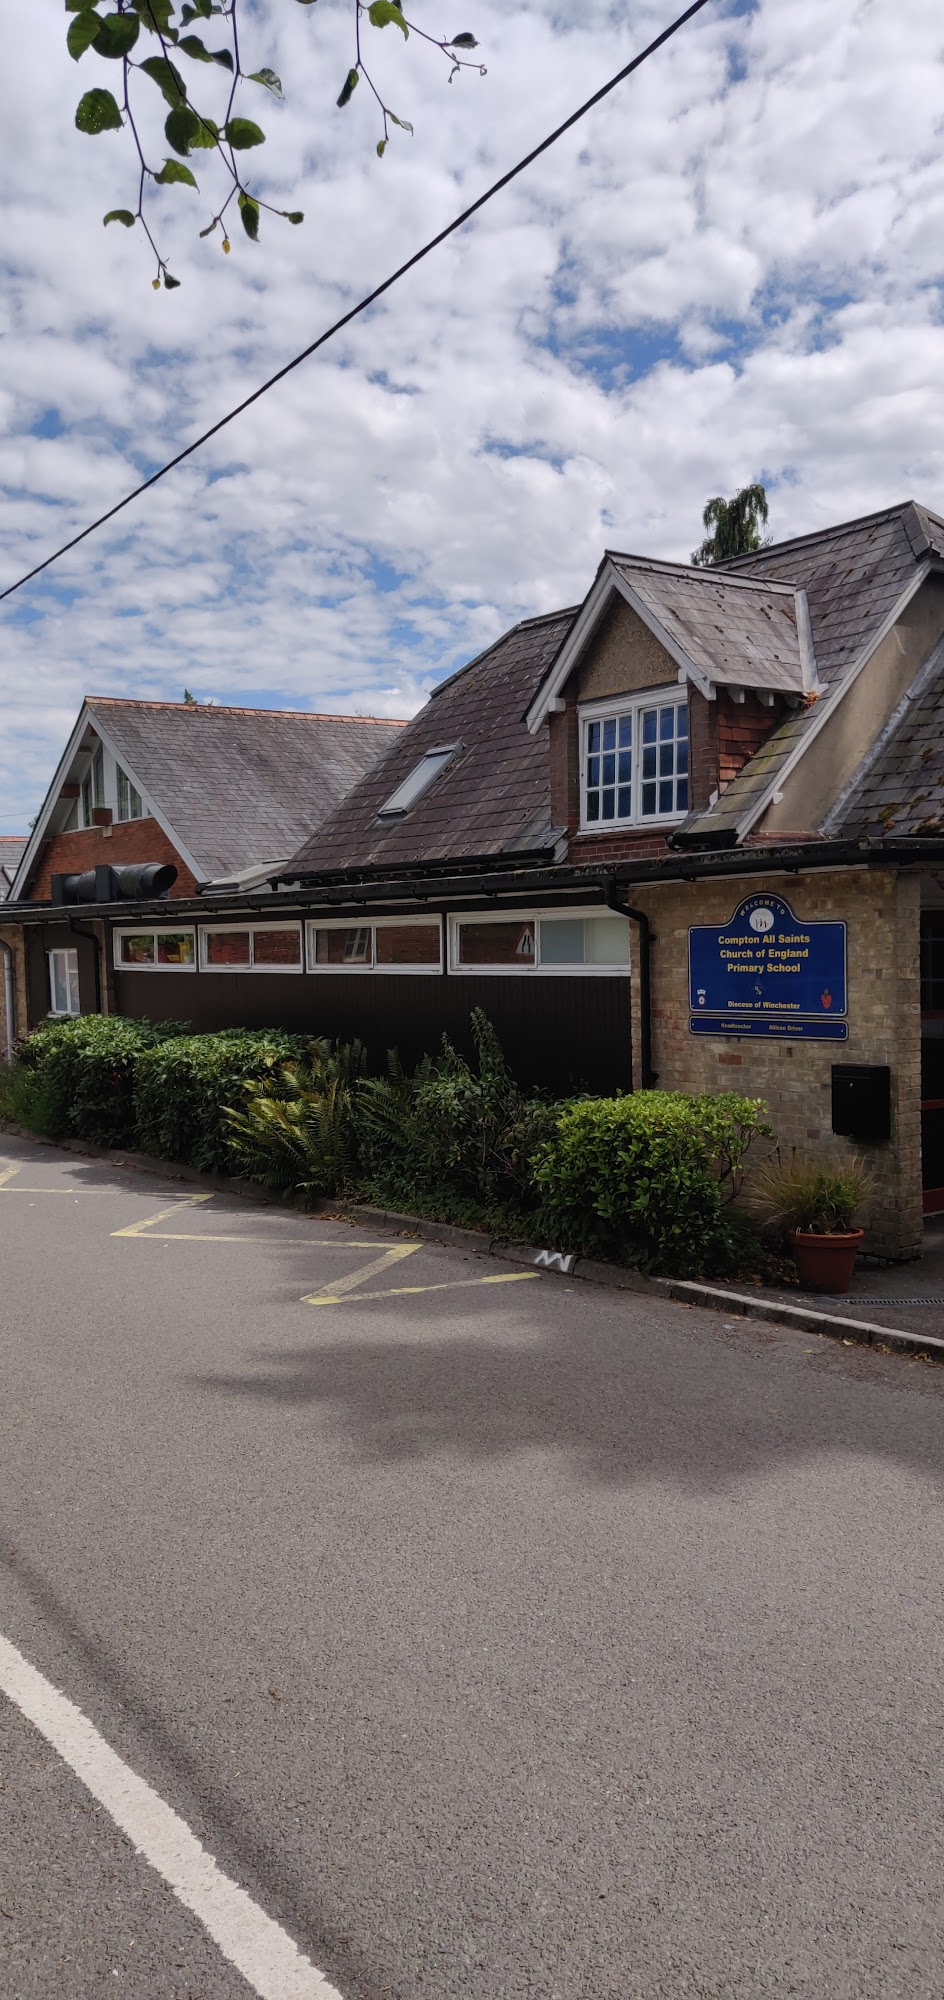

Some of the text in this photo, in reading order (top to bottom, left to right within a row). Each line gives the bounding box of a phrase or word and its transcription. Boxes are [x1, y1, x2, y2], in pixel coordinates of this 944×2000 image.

[740, 900, 785, 916] WELCOME TO
[718, 934, 810, 945] Compton All Saints
[720, 948, 808, 959] Church of England
[727, 963, 801, 974] Primary School
